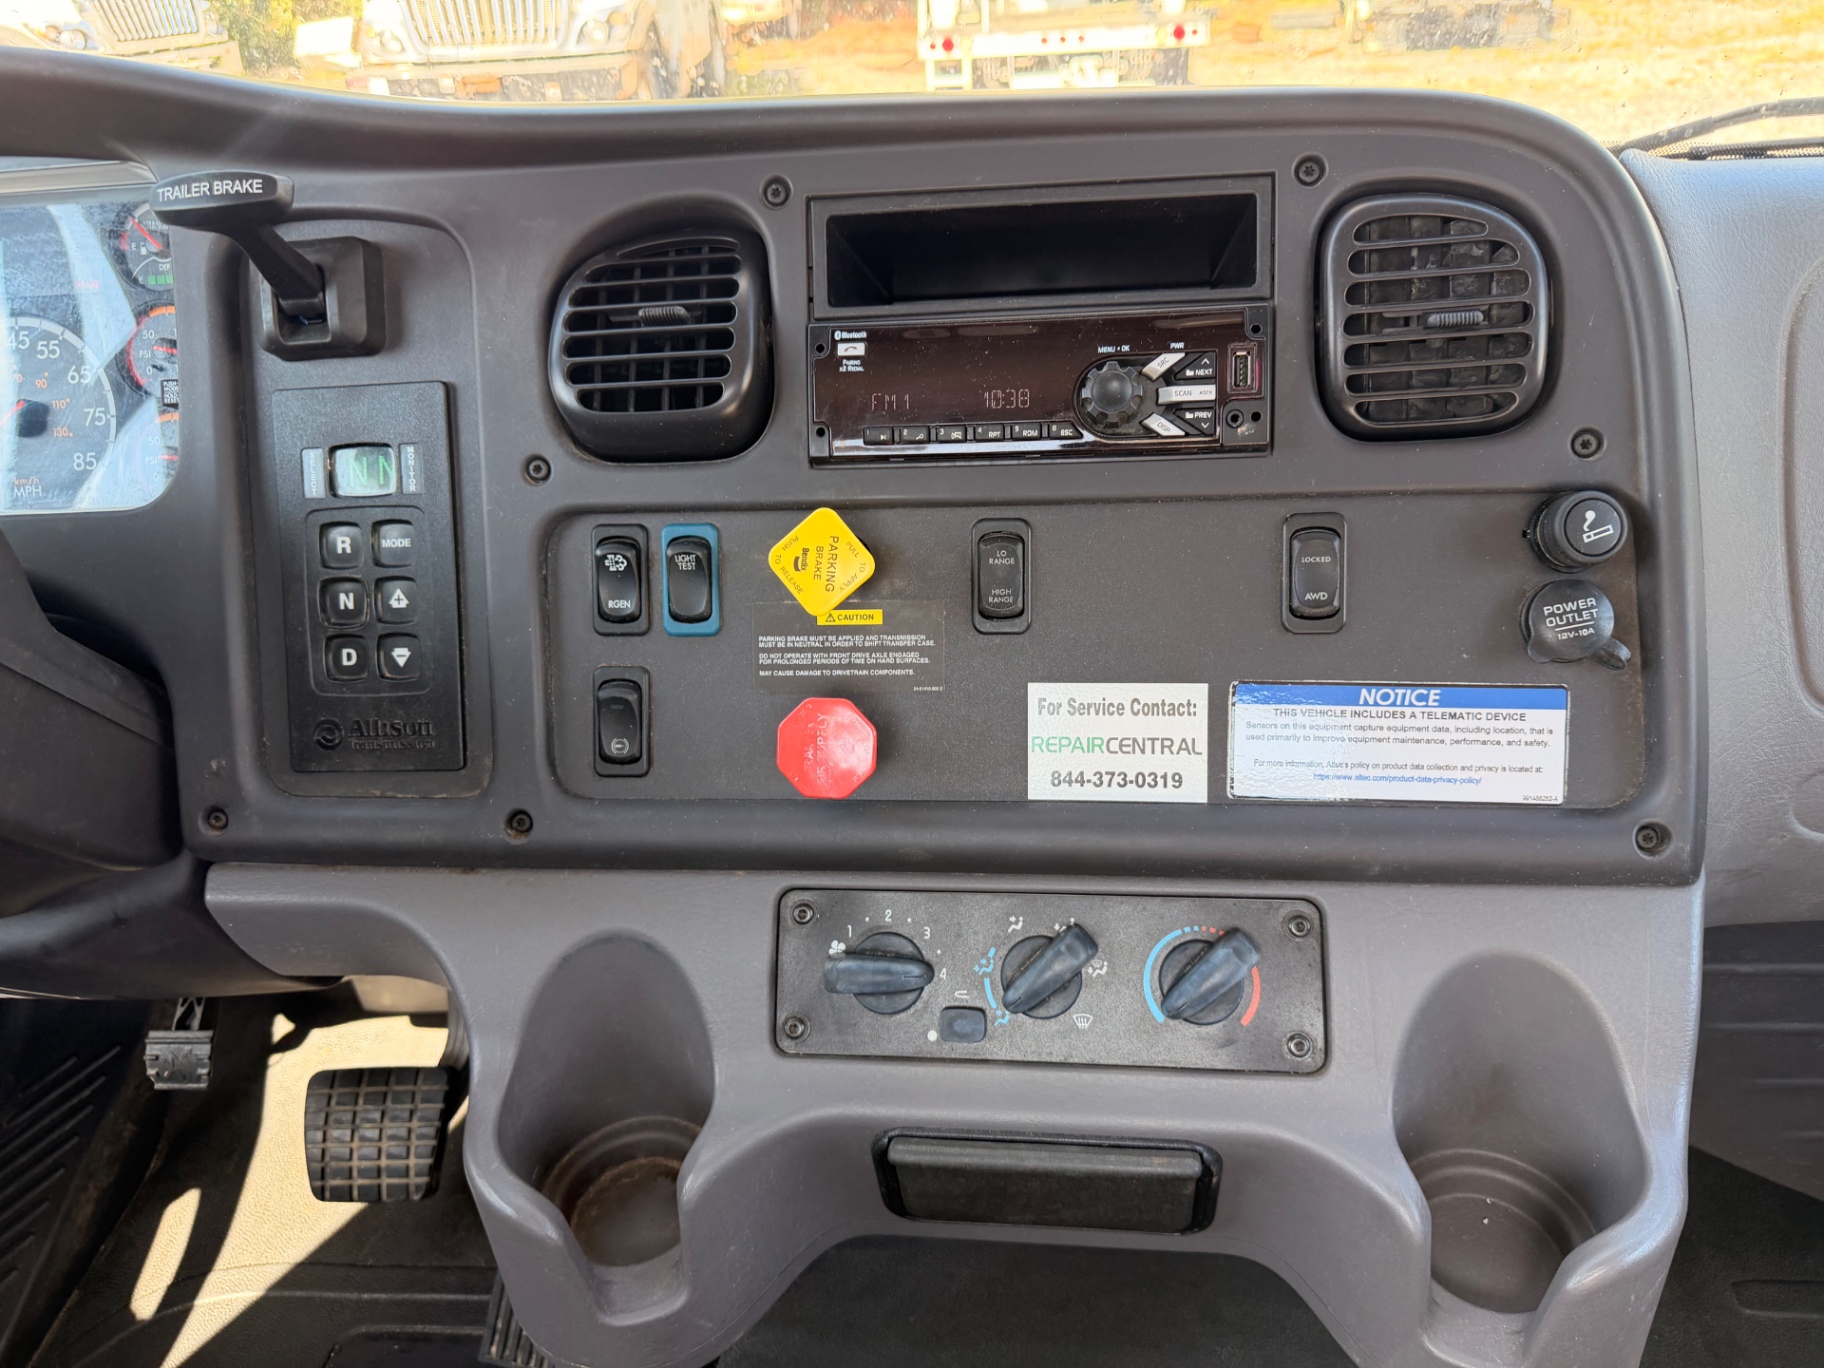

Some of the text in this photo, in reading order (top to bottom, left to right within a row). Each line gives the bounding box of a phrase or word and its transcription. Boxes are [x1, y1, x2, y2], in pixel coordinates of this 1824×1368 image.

[157, 179, 263, 202] TRAILER BRAKE
[6, 332, 30, 349] 45
[142, 330, 154, 339] 50
[37, 340, 60, 359] 55
[139, 350, 151, 358] PSI
[36, 379, 48, 388] 90
[68, 366, 91, 384] 65
[52, 400, 66, 409] 110
[984, 389, 1030, 408] 10:38
[84, 408, 106, 426] 75
[53, 428, 68, 437] 130
[73, 452, 97, 470] 85
[406, 446, 416, 492] MONITOR
[14, 476, 40, 486] km/h
[14, 485, 42, 498] MPH
[336, 537, 351, 554] R
[382, 538, 412, 548] MODE
[674, 554, 696, 562] LIGHT
[774, 535, 804, 595] PUSH TO RELEASE
[800, 548, 810, 571] Bendix
[814, 546, 824, 580] BRAKE
[825, 536, 840, 592] PARKING
[846, 542, 859, 558] PULL
[860, 562, 866, 572] TO
[339, 593, 354, 610] N
[608, 600, 631, 608] RGEN
[1304, 592, 1328, 600] AWD
[1543, 598, 1596, 616] POWER
[1546, 608, 1598, 627] OUTLET
[1558, 628, 1595, 640] 12V-10A
[342, 650, 358, 666] D
[1359, 688, 1440, 706] NOTICE
[1038, 698, 1197, 717] For Service Contact:
[1273, 708, 1526, 722] THIS VEHICLE INCLUDES A TELEMATIC DEVICE
[348, 718, 436, 737] Allison
[1246, 721, 1278, 730] Sensors
[1308, 723, 1351, 732] equipment
[1354, 724, 1383, 732] capture
[1386, 725, 1429, 734] equipment
[1432, 726, 1452, 734] data,
[1454, 726, 1490, 735] including
[1493, 727, 1527, 735] location,
[1032, 736, 1202, 756] REPAIRCENTRAL
[1267, 734, 1301, 743] primarily
[1313, 735, 1346, 743] improve
[1348, 736, 1390, 744] equipment
[1393, 736, 1448, 745] maintenance,
[1450, 738, 1504, 746] performance,
[1524, 740, 1550, 748] safety.
[1350, 762, 1369, 770] policy
[1382, 762, 1408, 771] product
[1474, 765, 1498, 773] privacy
[1050, 770, 1183, 788] 844-373-0319
[884, 909, 892, 922] 2
[847, 924, 852, 938] 1
[924, 926, 931, 939] 3
[940, 968, 947, 980] 4
